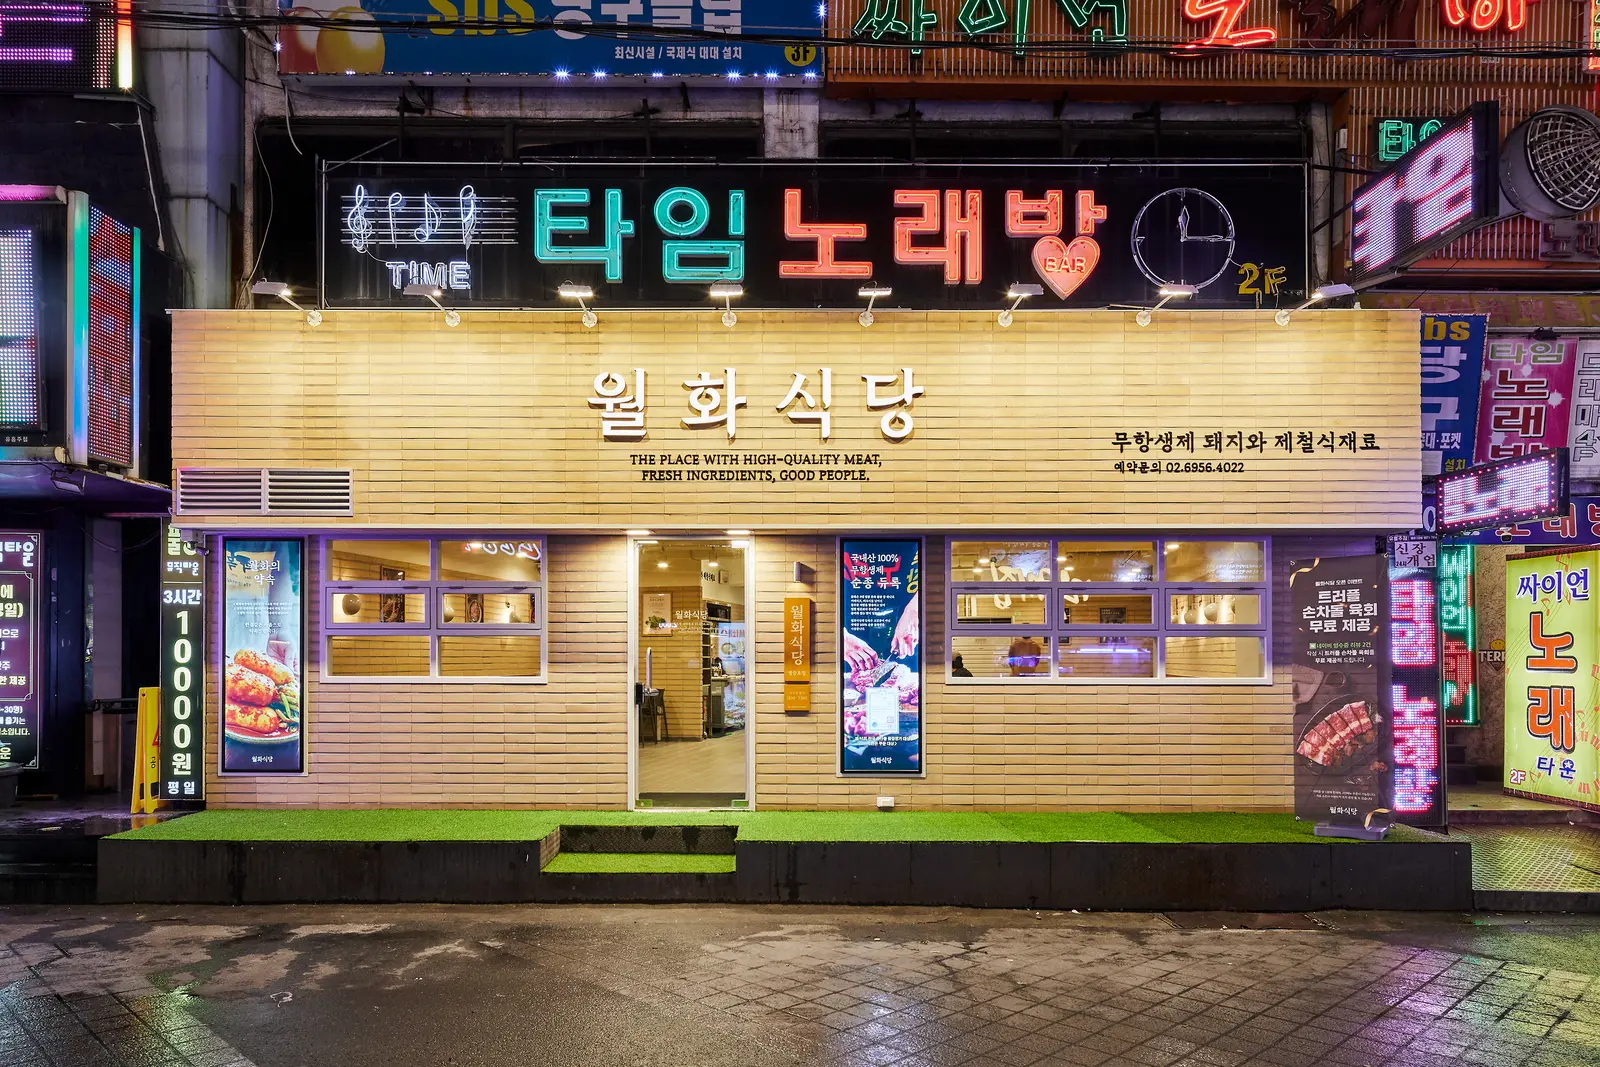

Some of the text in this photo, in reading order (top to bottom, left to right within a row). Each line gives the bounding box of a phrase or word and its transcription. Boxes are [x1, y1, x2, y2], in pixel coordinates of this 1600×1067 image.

[614, 46, 655, 60] 최신시설
[666, 46, 697, 60] 국제식
[699, 46, 719, 60] 대대
[722, 46, 742, 60] 설치
[533, 186, 746, 284] 타임
[1045, 256, 1087, 274] BAR
[386, 261, 471, 291] TIME
[1237, 262, 1288, 296] 2F
[1488, 342, 1565, 365] 타임
[586, 367, 925, 442] 월화식당
[1111, 430, 1381, 454] 무항생제 돼지와 제철식재료
[630, 454, 882, 468] THE PLACE WITH HIGH-QUALITY MEAT,
[1114, 461, 1245, 474] 예약문의 02.6956.4022
[1444, 458, 1467, 472] 설치
[641, 470, 870, 483] FRESH INGREDIENTS, GOOD PEOPLE.
[1395, 542, 1427, 555] 신장
[850, 553, 899, 563] 국내산 100%
[1407, 554, 1436, 567] 개업
[850, 565, 884, 576] 무항생제
[253, 573, 276, 586] 약속
[850, 577, 902, 590] 순종 듀록
[1516, 567, 1591, 604] 싸이언
[162, 589, 202, 605] 3시간
[1318, 588, 1360, 604] 트러플
[675, 609, 708, 620] 월화식당
[1302, 602, 1378, 619] 손차돌 육회
[1309, 618, 1371, 633] 무료 제공
[789, 604, 805, 666] 월화식당
[1525, 610, 1578, 754] 노래
[171, 610, 193, 776] 10000원
[1509, 767, 1527, 785] 2F
[1537, 756, 1577, 780] 타운
